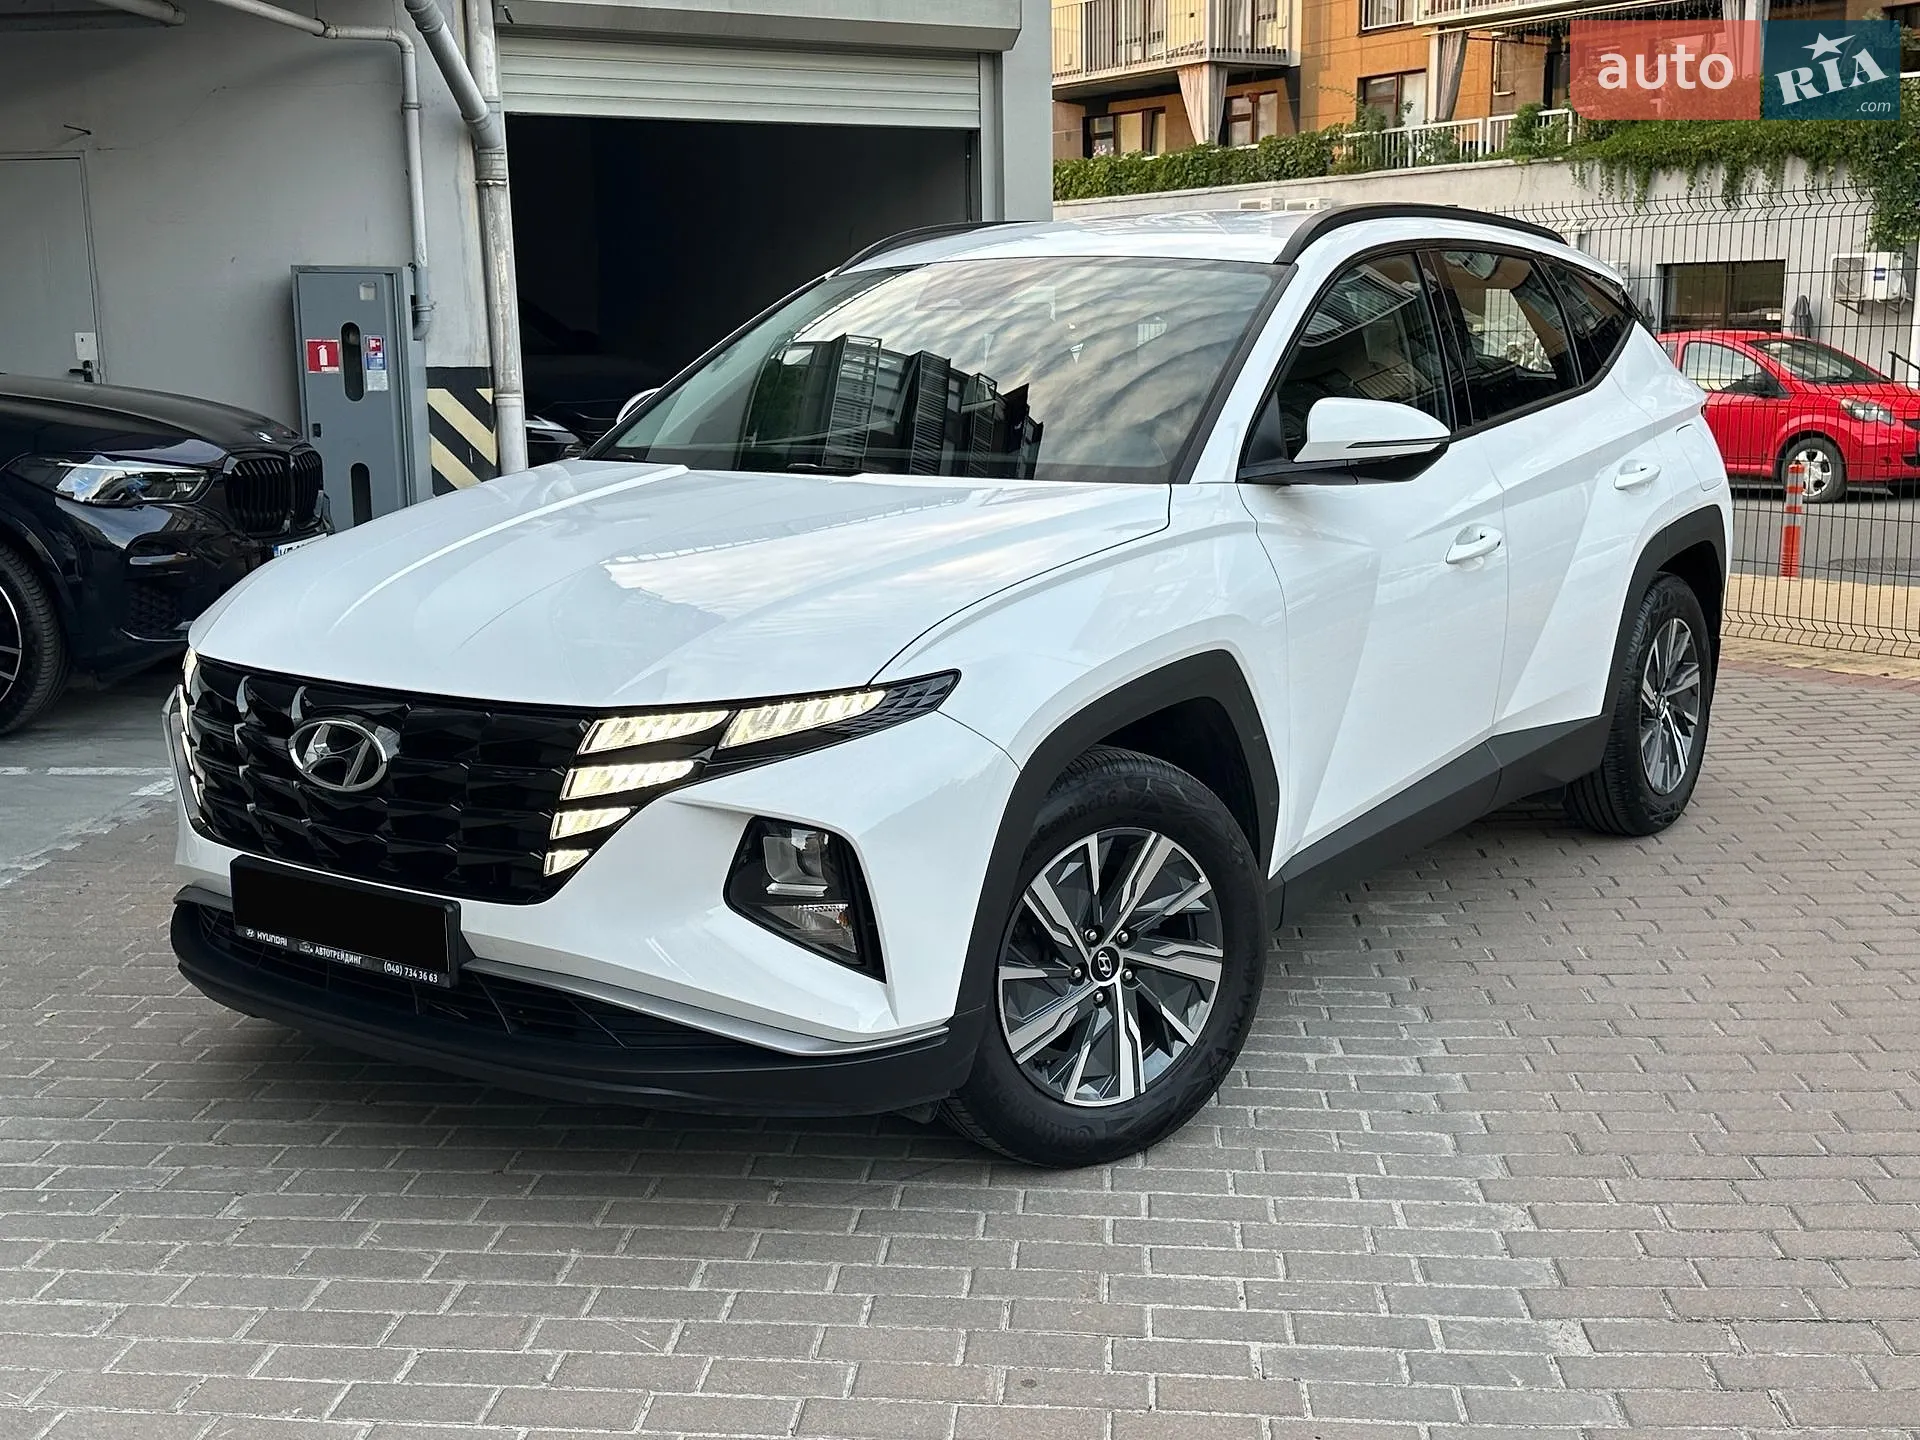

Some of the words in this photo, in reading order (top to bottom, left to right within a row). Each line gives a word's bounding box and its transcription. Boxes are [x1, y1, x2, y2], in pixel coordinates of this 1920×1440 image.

[257, 931, 288, 947] HYUNDAI
[384, 961, 403, 977] (048)
[404, 967, 418, 979] 734
[418, 970, 428, 981] 36
[428, 973, 438, 983] 63
